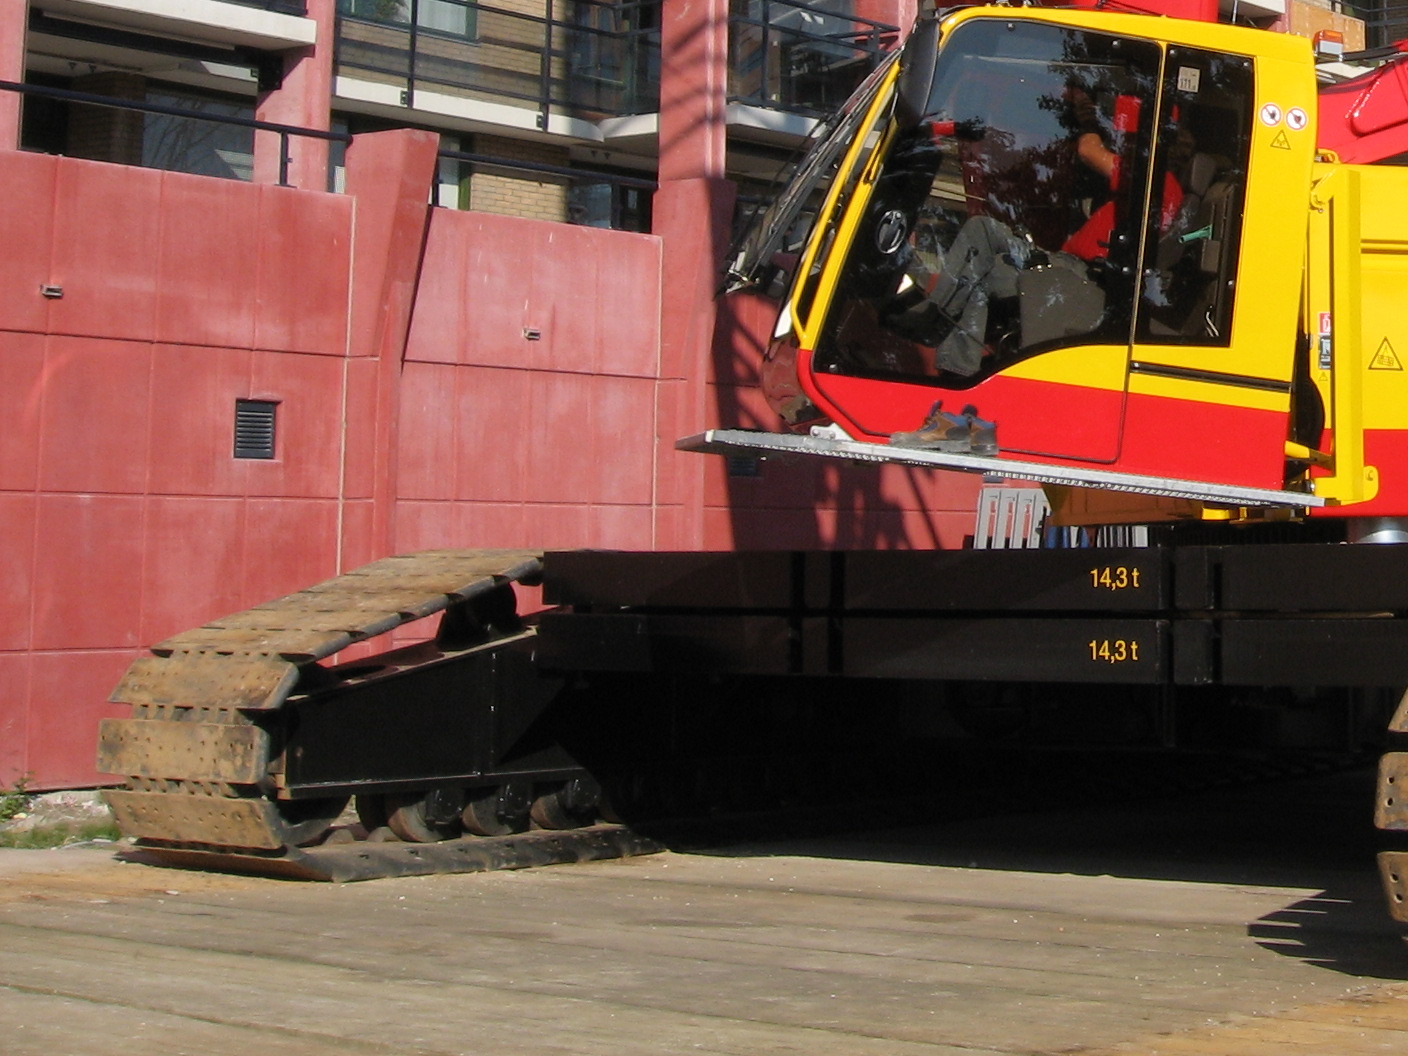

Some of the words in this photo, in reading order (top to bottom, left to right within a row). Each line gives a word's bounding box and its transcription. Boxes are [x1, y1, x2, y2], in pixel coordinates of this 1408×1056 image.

[1090, 567, 1128, 591] 14,3
[1132, 568, 1140, 588] t
[1089, 640, 1127, 664] 14,3
[1130, 640, 1138, 661] t
